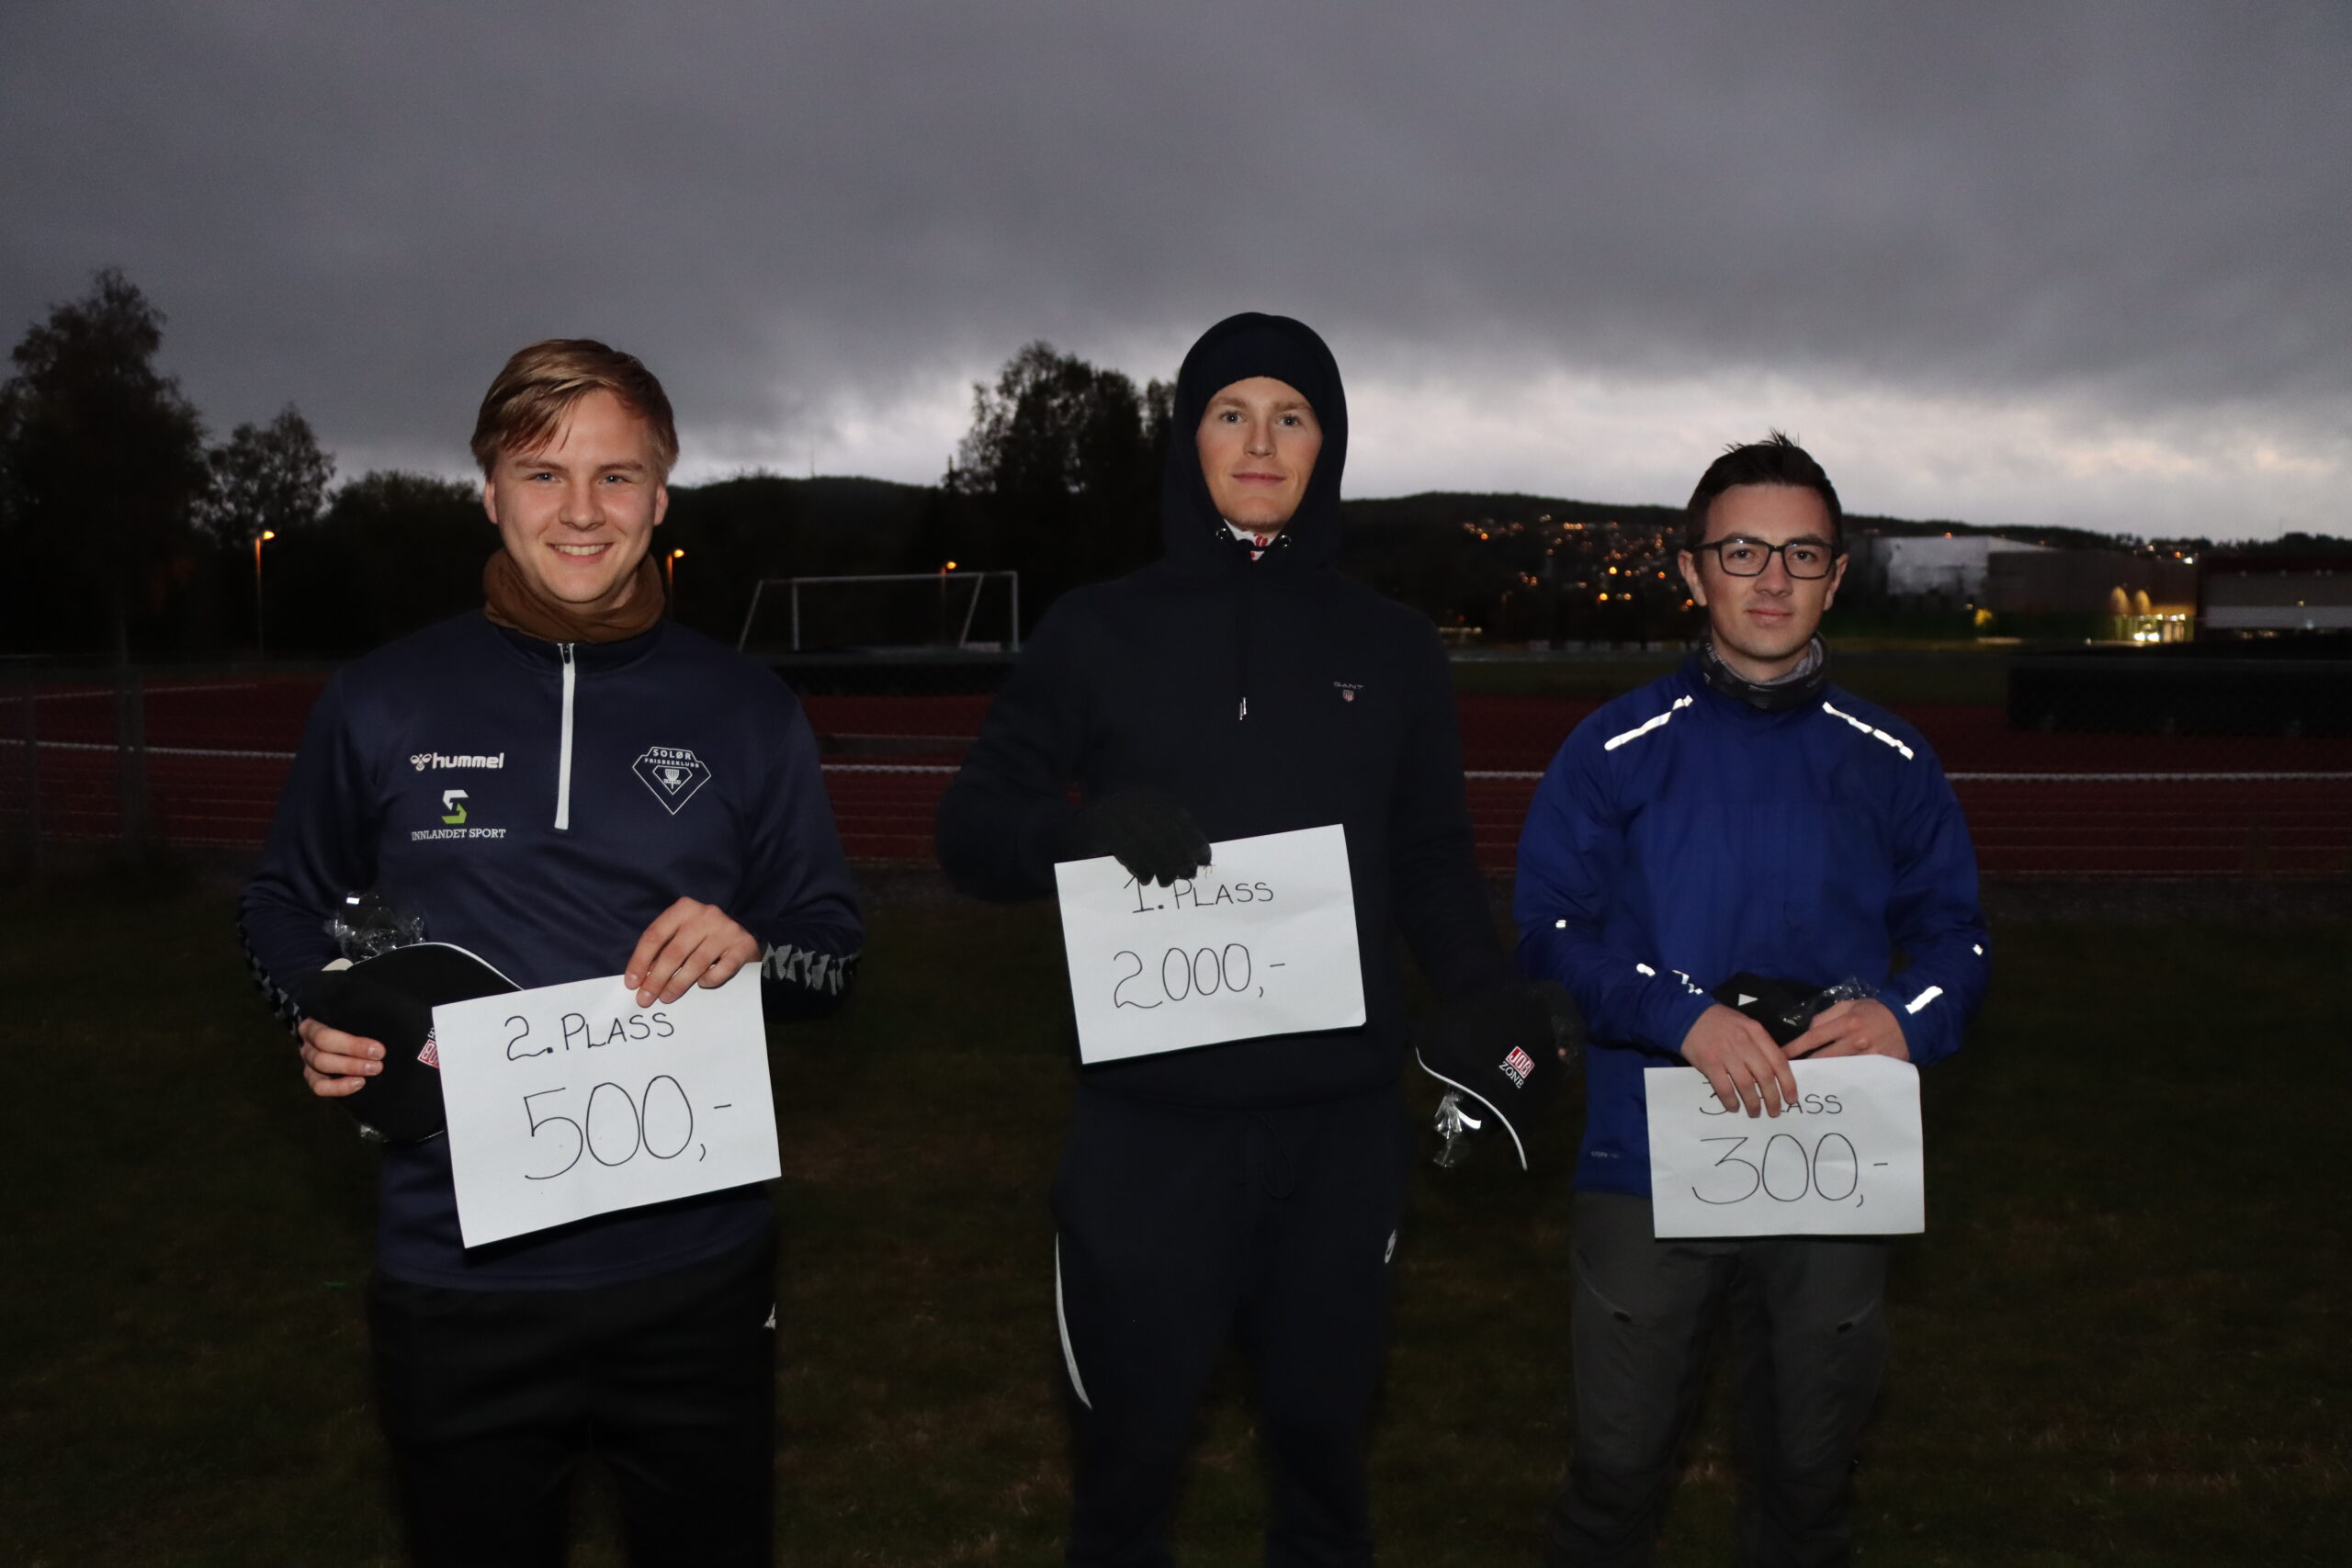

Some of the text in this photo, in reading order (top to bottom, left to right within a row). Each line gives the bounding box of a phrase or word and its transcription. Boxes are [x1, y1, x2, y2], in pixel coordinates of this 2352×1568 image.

[432, 751, 504, 770] hummel
[652, 749, 692, 761] SOLØR
[412, 828, 507, 841] INNLANDET SPORT
[1172, 877, 1274, 909] PLASS
[561, 1012, 674, 1051] PLASS
[1498, 1060, 1524, 1089] ZONE
[1508, 1049, 1533, 1077] JOB
[523, 1075, 732, 1180] 500,-
[1691, 1133, 1889, 1208] 300,-
